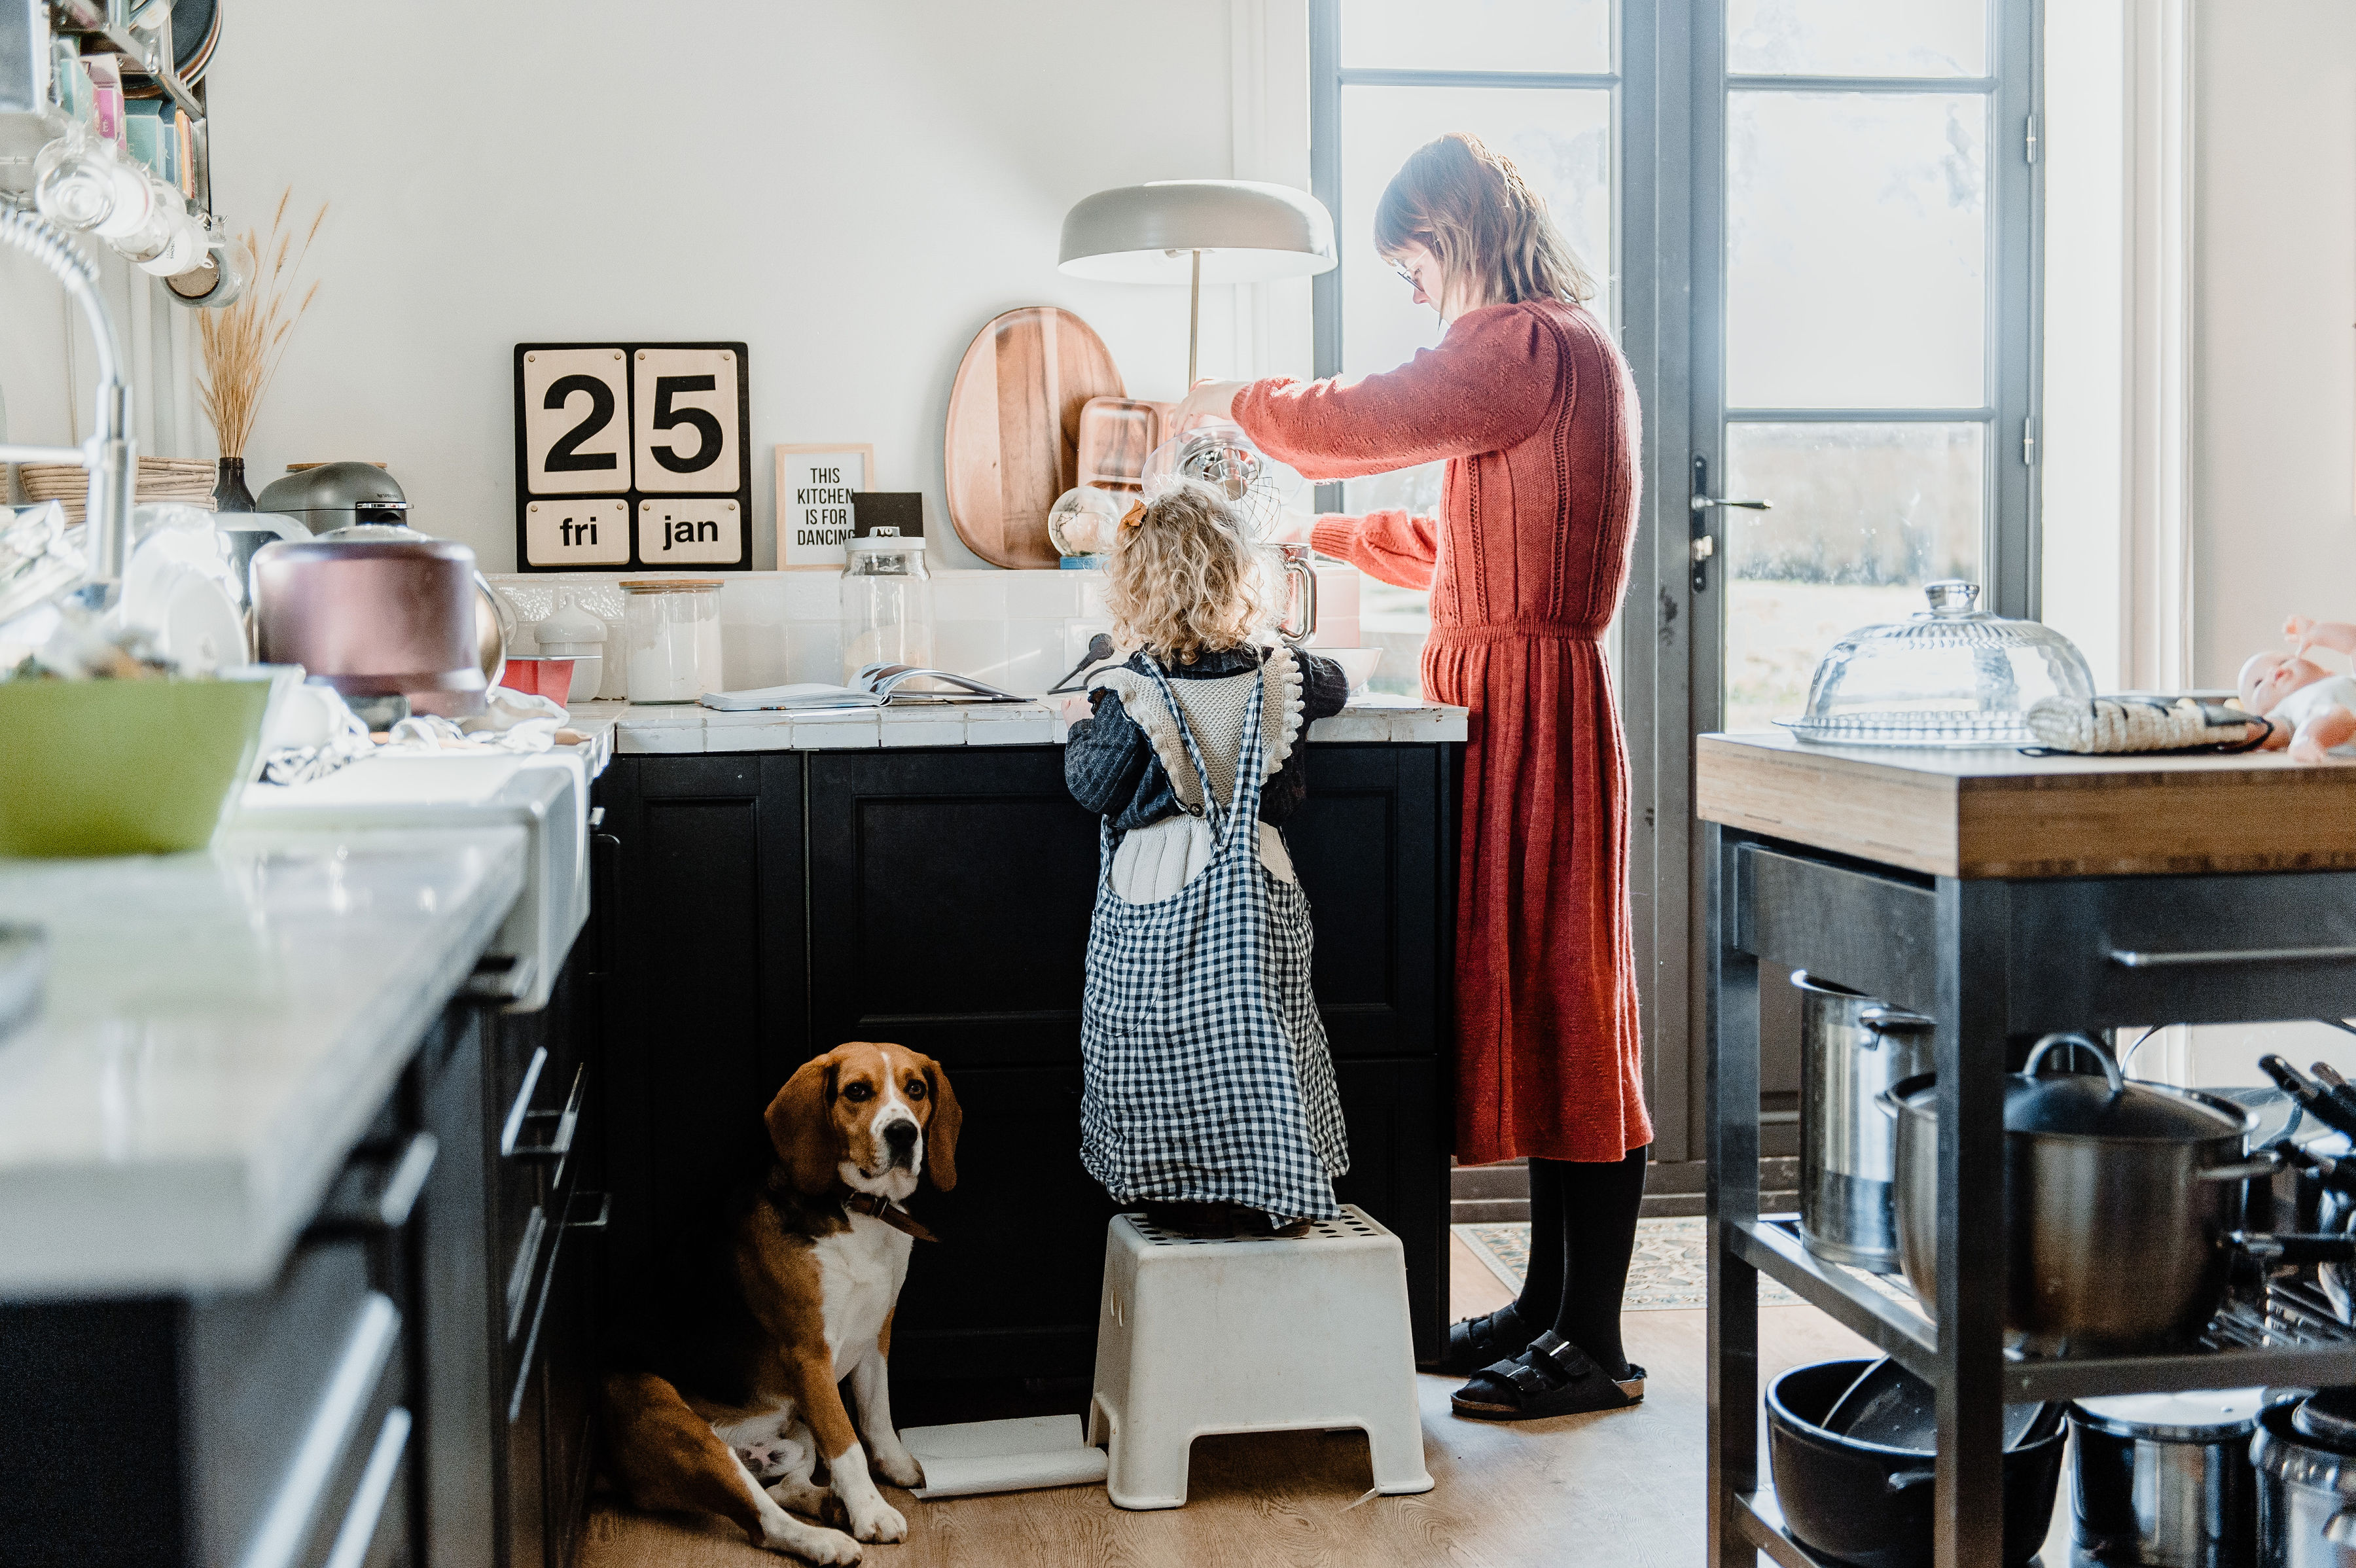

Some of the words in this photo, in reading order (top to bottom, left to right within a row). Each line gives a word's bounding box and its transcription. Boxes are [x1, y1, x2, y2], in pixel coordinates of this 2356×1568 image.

[810, 468, 840, 484] THIS
[797, 488, 853, 504] KITCHEN
[806, 509, 817, 525] IS
[822, 509, 847, 525] FOR
[560, 517, 598, 546] fri
[662, 515, 719, 551] jan
